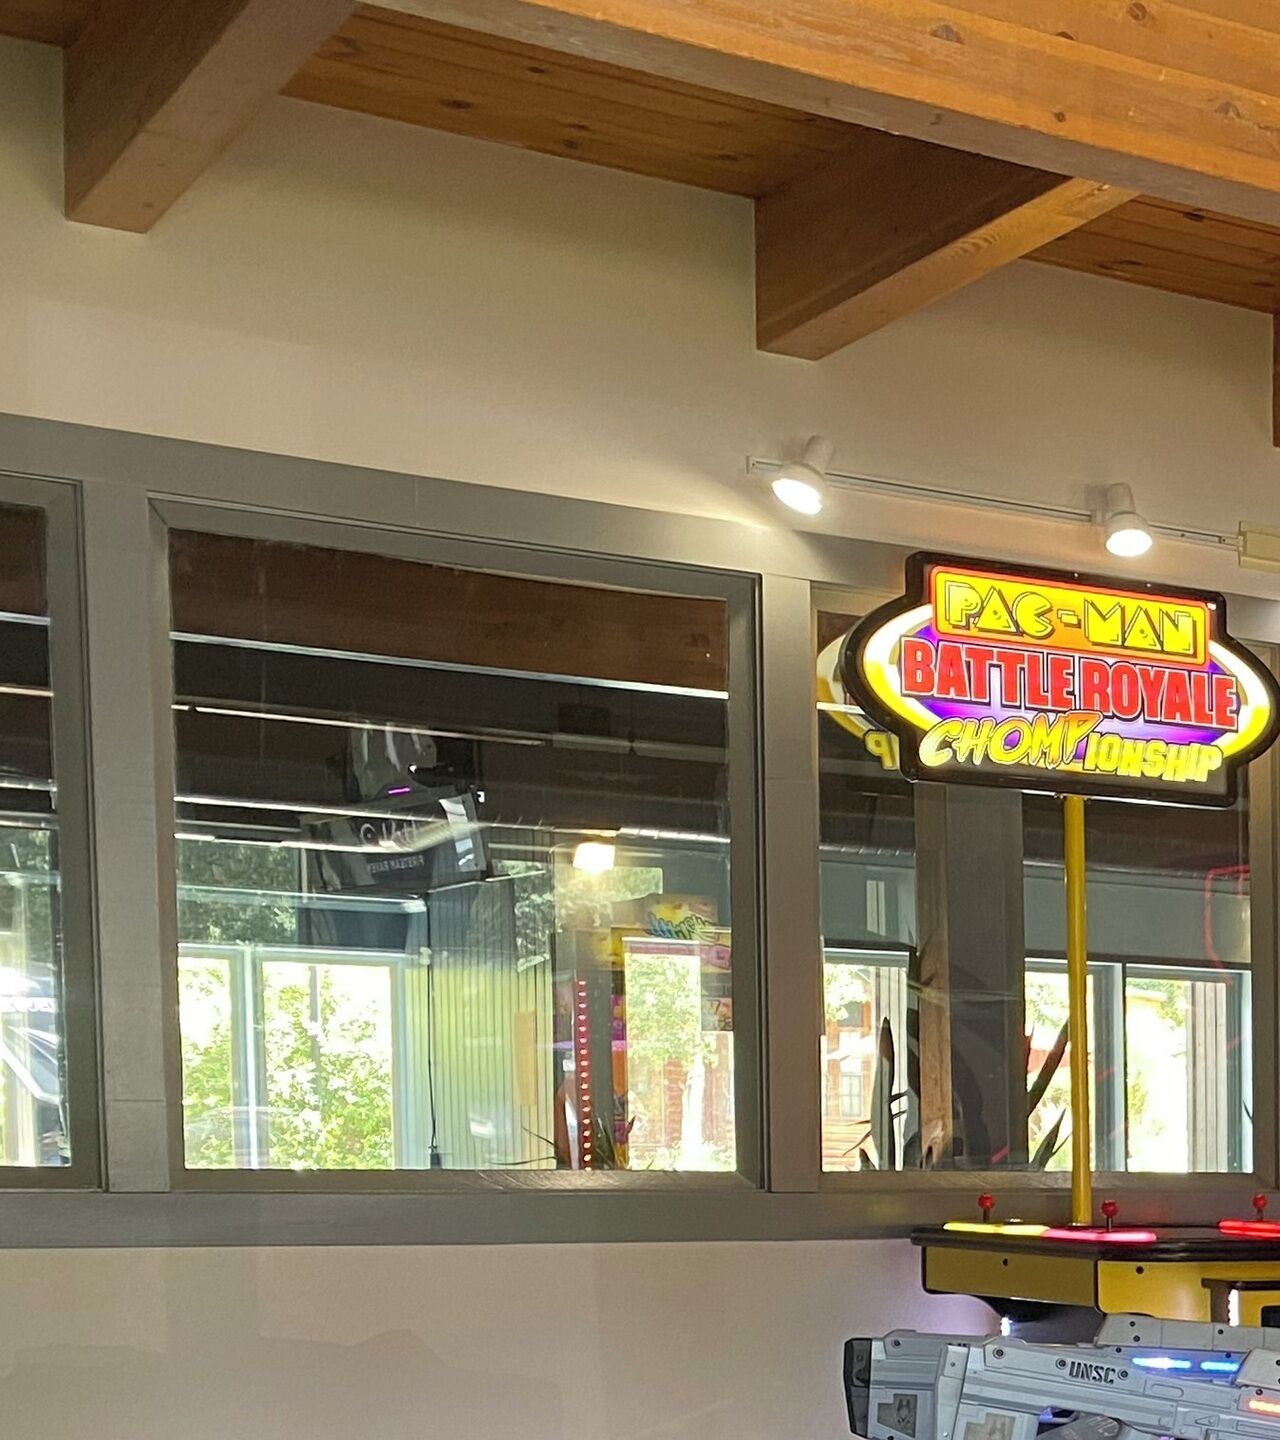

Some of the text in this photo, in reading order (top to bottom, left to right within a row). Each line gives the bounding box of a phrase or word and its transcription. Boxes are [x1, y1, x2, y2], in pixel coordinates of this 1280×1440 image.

[943, 579, 1200, 656] PAC-MAN
[902, 636, 1240, 733] BATTLE ROYALE
[1068, 1360, 1117, 1385] UNSC
